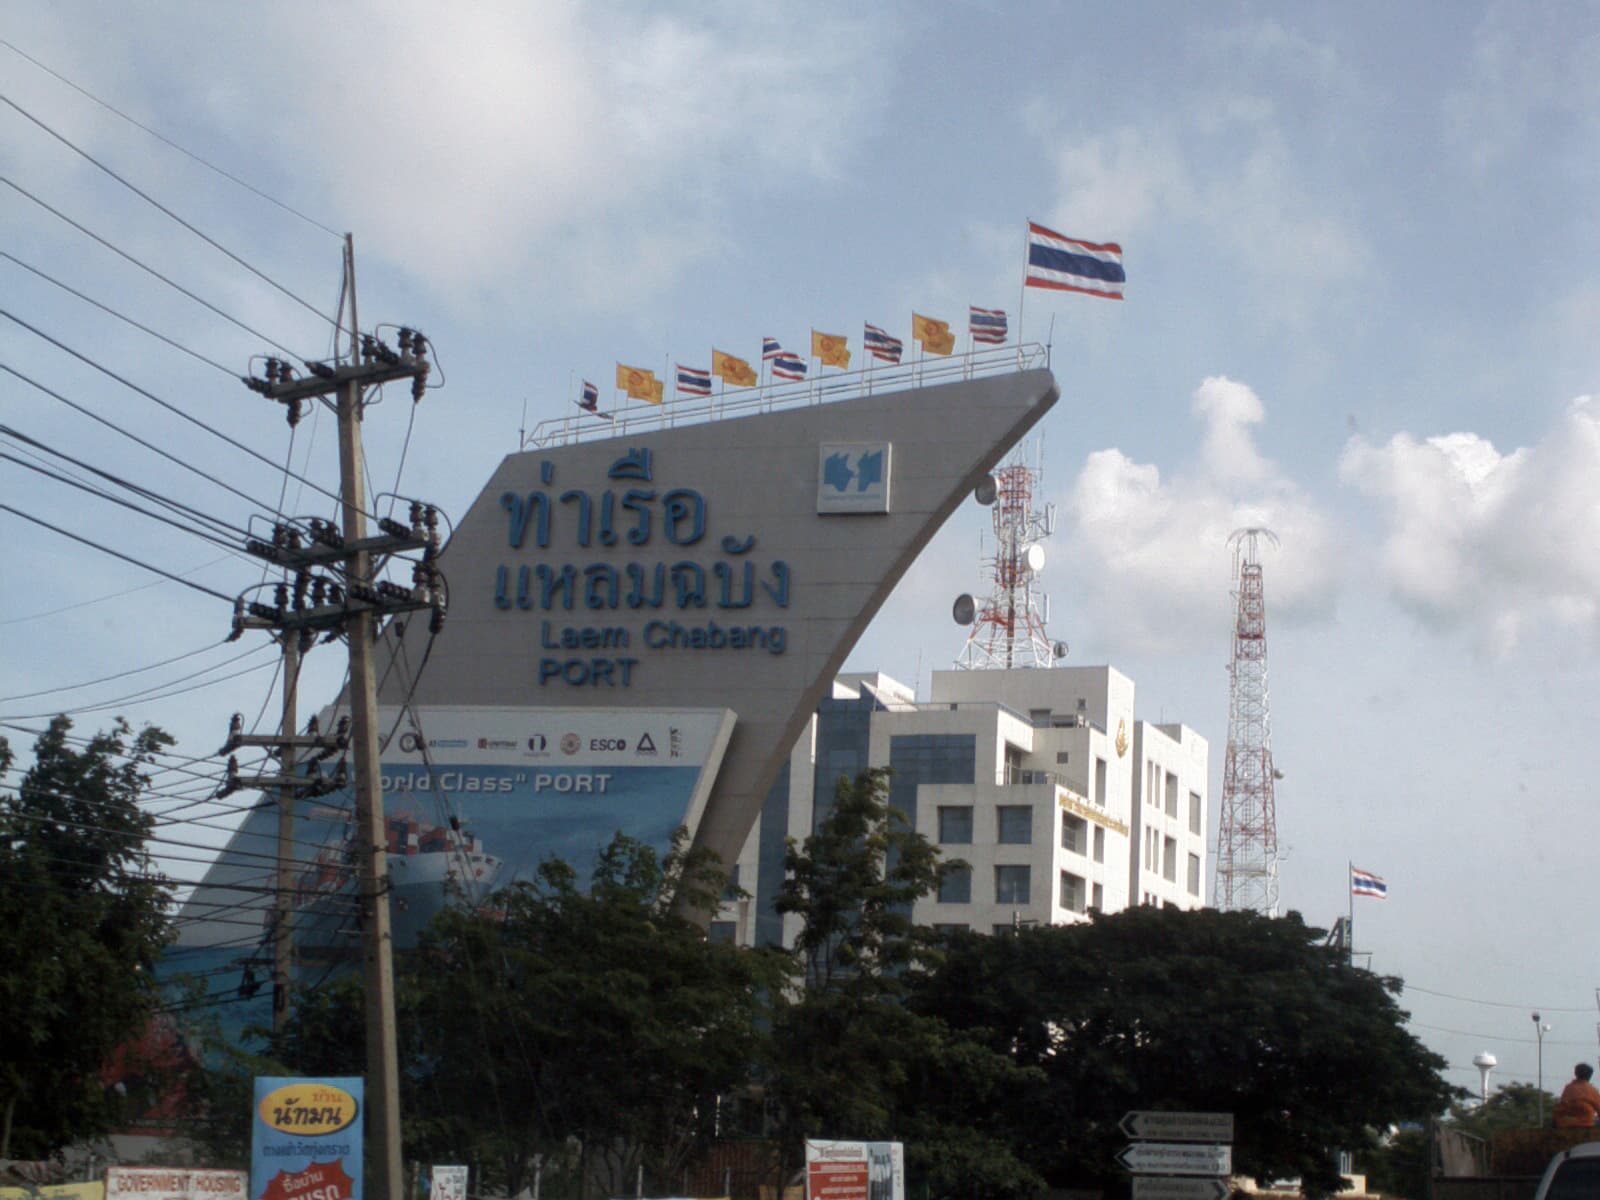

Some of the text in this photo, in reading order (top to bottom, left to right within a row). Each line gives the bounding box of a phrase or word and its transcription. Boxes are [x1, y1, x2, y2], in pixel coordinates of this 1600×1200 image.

[501, 447, 707, 548] ท่าเรือ
[494, 534, 791, 611] แหลมฉบัง
[541, 620, 787, 655] Laem Chabang
[538, 658, 639, 688] PORT
[590, 738, 627, 752] ESCO
[535, 774, 612, 793] PORT
[117, 1174, 241, 1193] GOVERNMENT HOUSING
